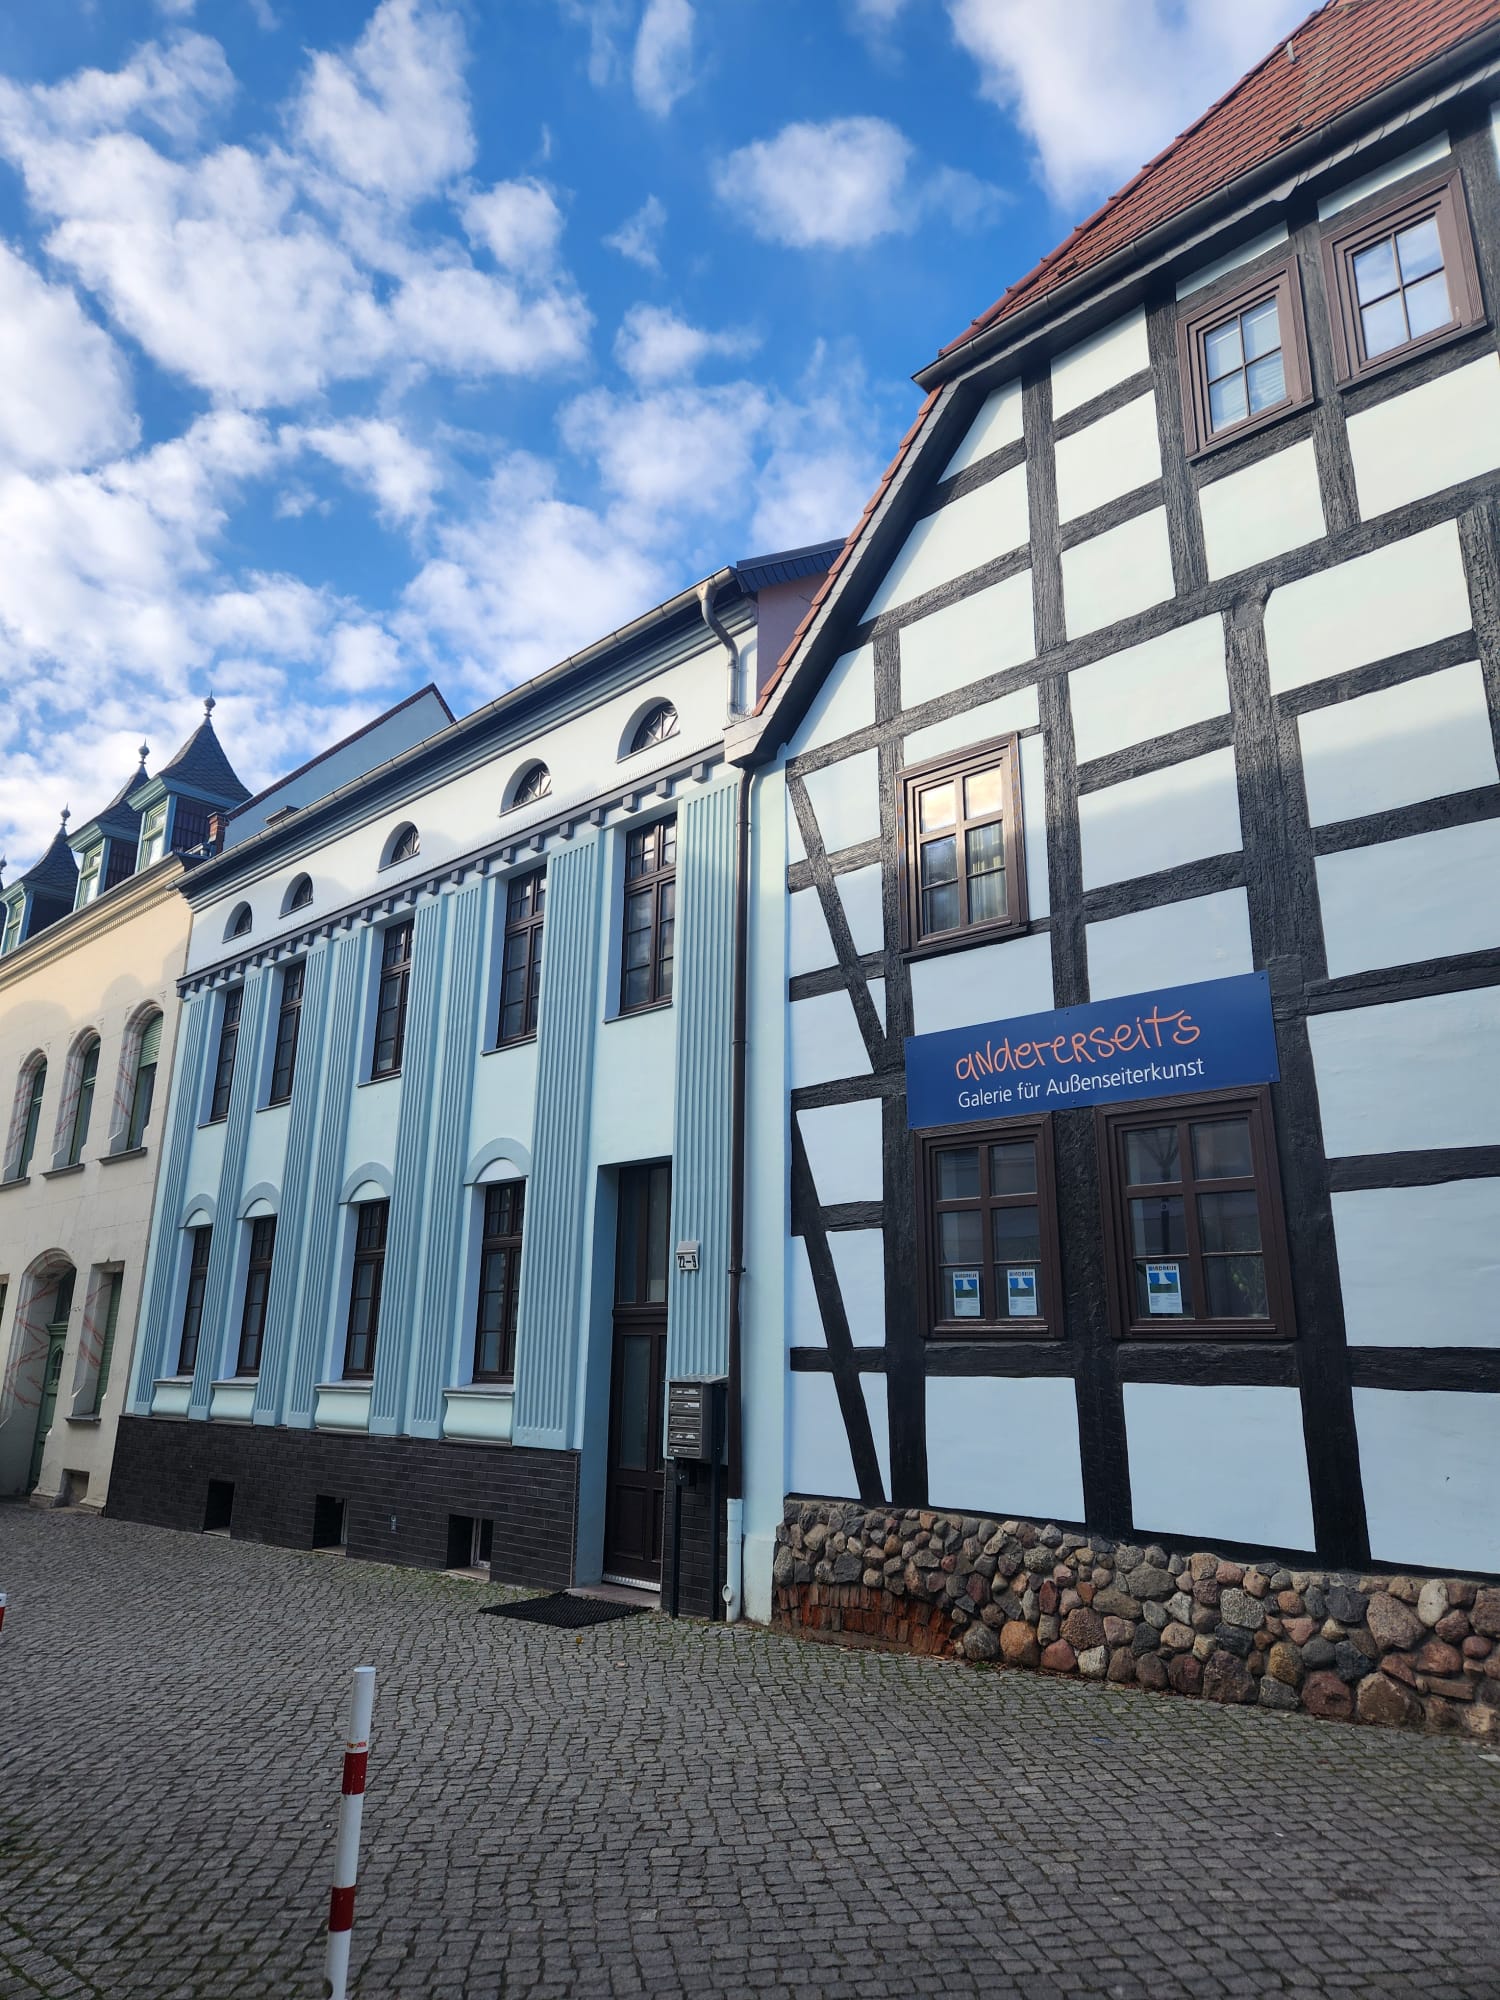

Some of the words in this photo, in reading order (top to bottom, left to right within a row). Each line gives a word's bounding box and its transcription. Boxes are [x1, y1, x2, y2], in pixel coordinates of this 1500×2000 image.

[958, 1086, 1012, 1108] Galerie
[1017, 1081, 1041, 1100] für
[1046, 1058, 1205, 1096] Außenseiterkunst
